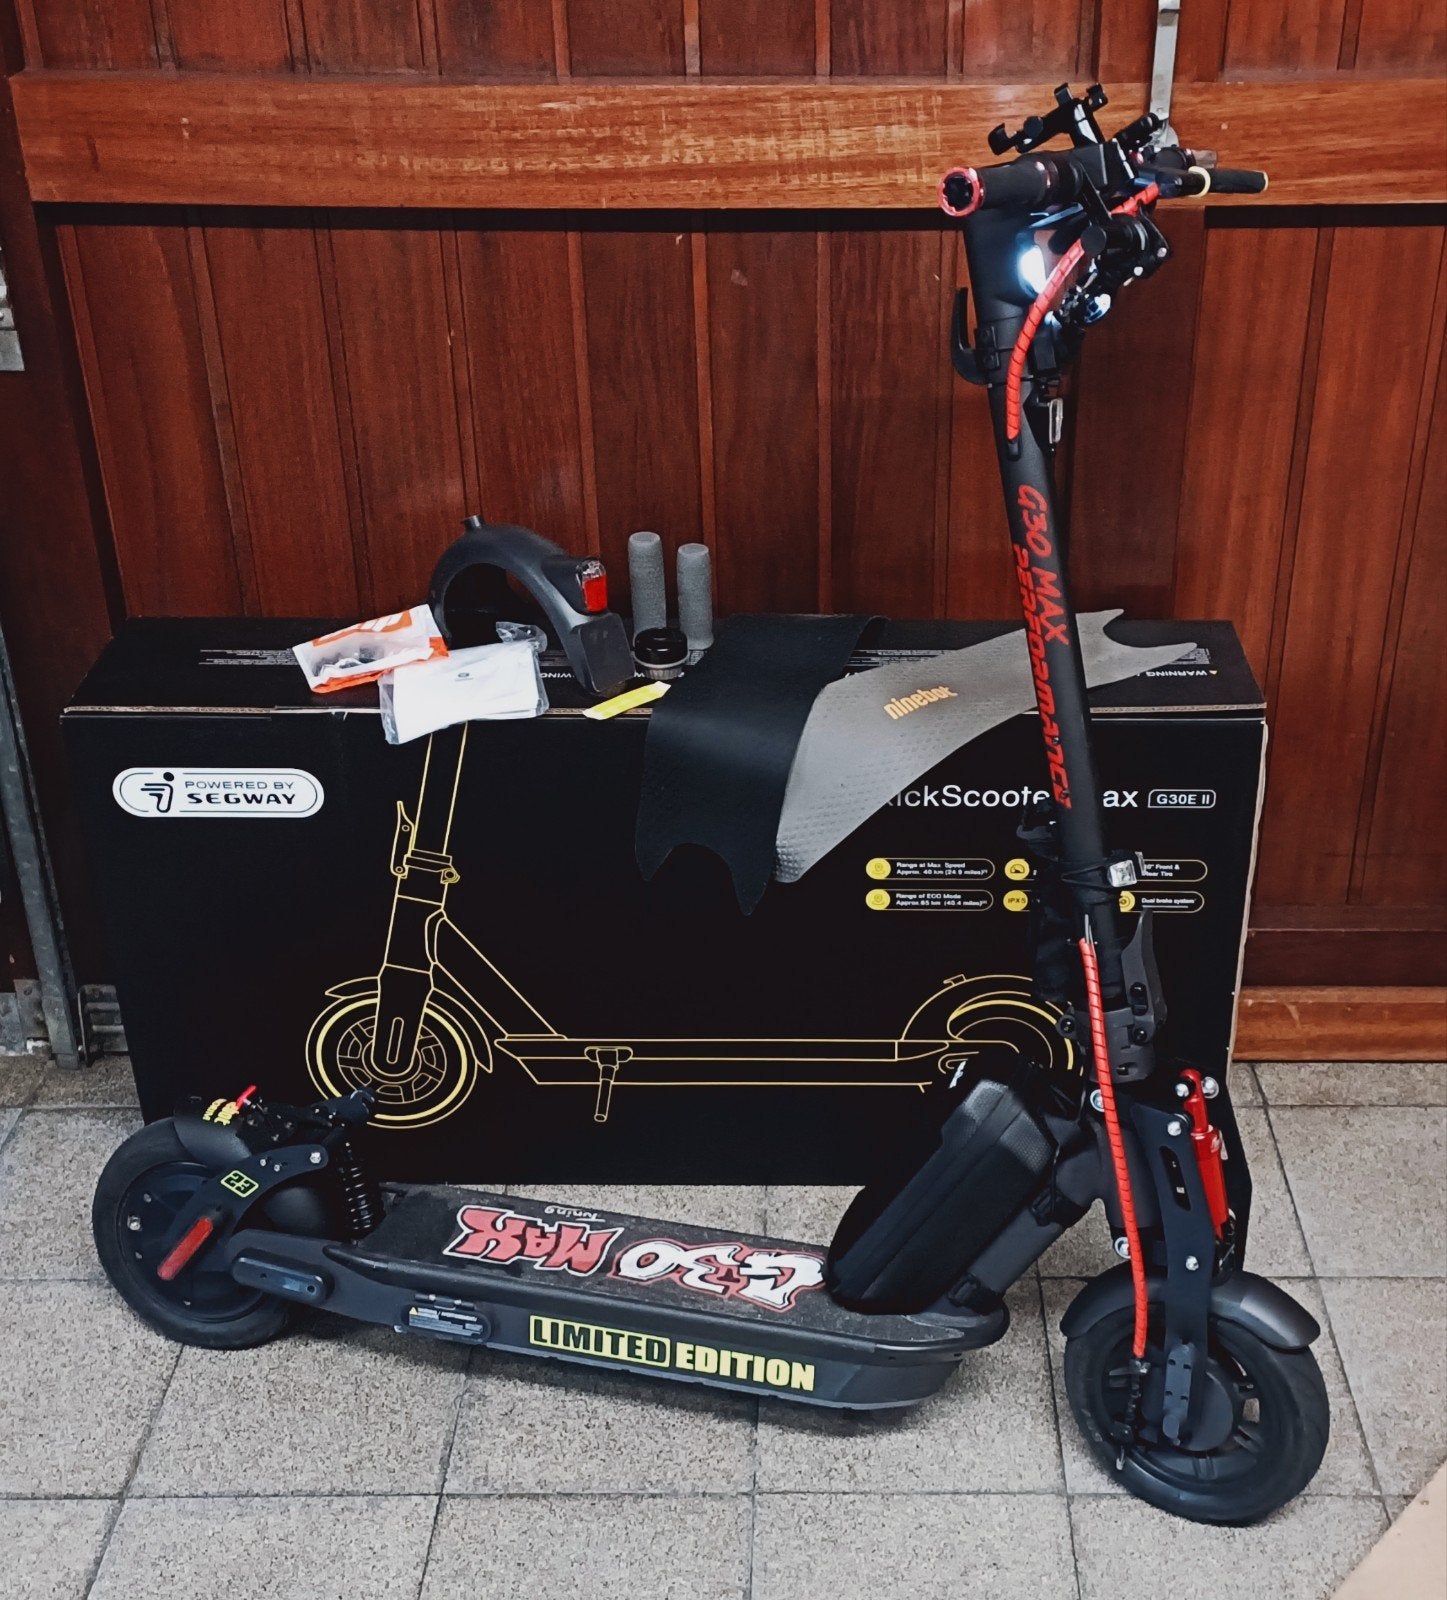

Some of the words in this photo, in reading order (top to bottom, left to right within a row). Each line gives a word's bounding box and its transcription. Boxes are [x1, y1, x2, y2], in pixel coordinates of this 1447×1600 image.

[1018, 484, 1052, 558] G30
[1031, 566, 1070, 646] MAX
[883, 683, 958, 720] ninebot
[185, 780, 268, 789] POWERED
[274, 781, 294, 789] BY
[187, 792, 296, 804] SEGWAY
[1102, 788, 1139, 808] ax
[1157, 793, 1197, 805] G30E
[223, 1172, 256, 1196] 23
[544, 1205, 606, 1222] Tuning
[443, 1205, 623, 1276] MAX
[613, 1240, 825, 1311] G30
[531, 1317, 669, 1366] LIMITED
[675, 1342, 816, 1392] EDITION
